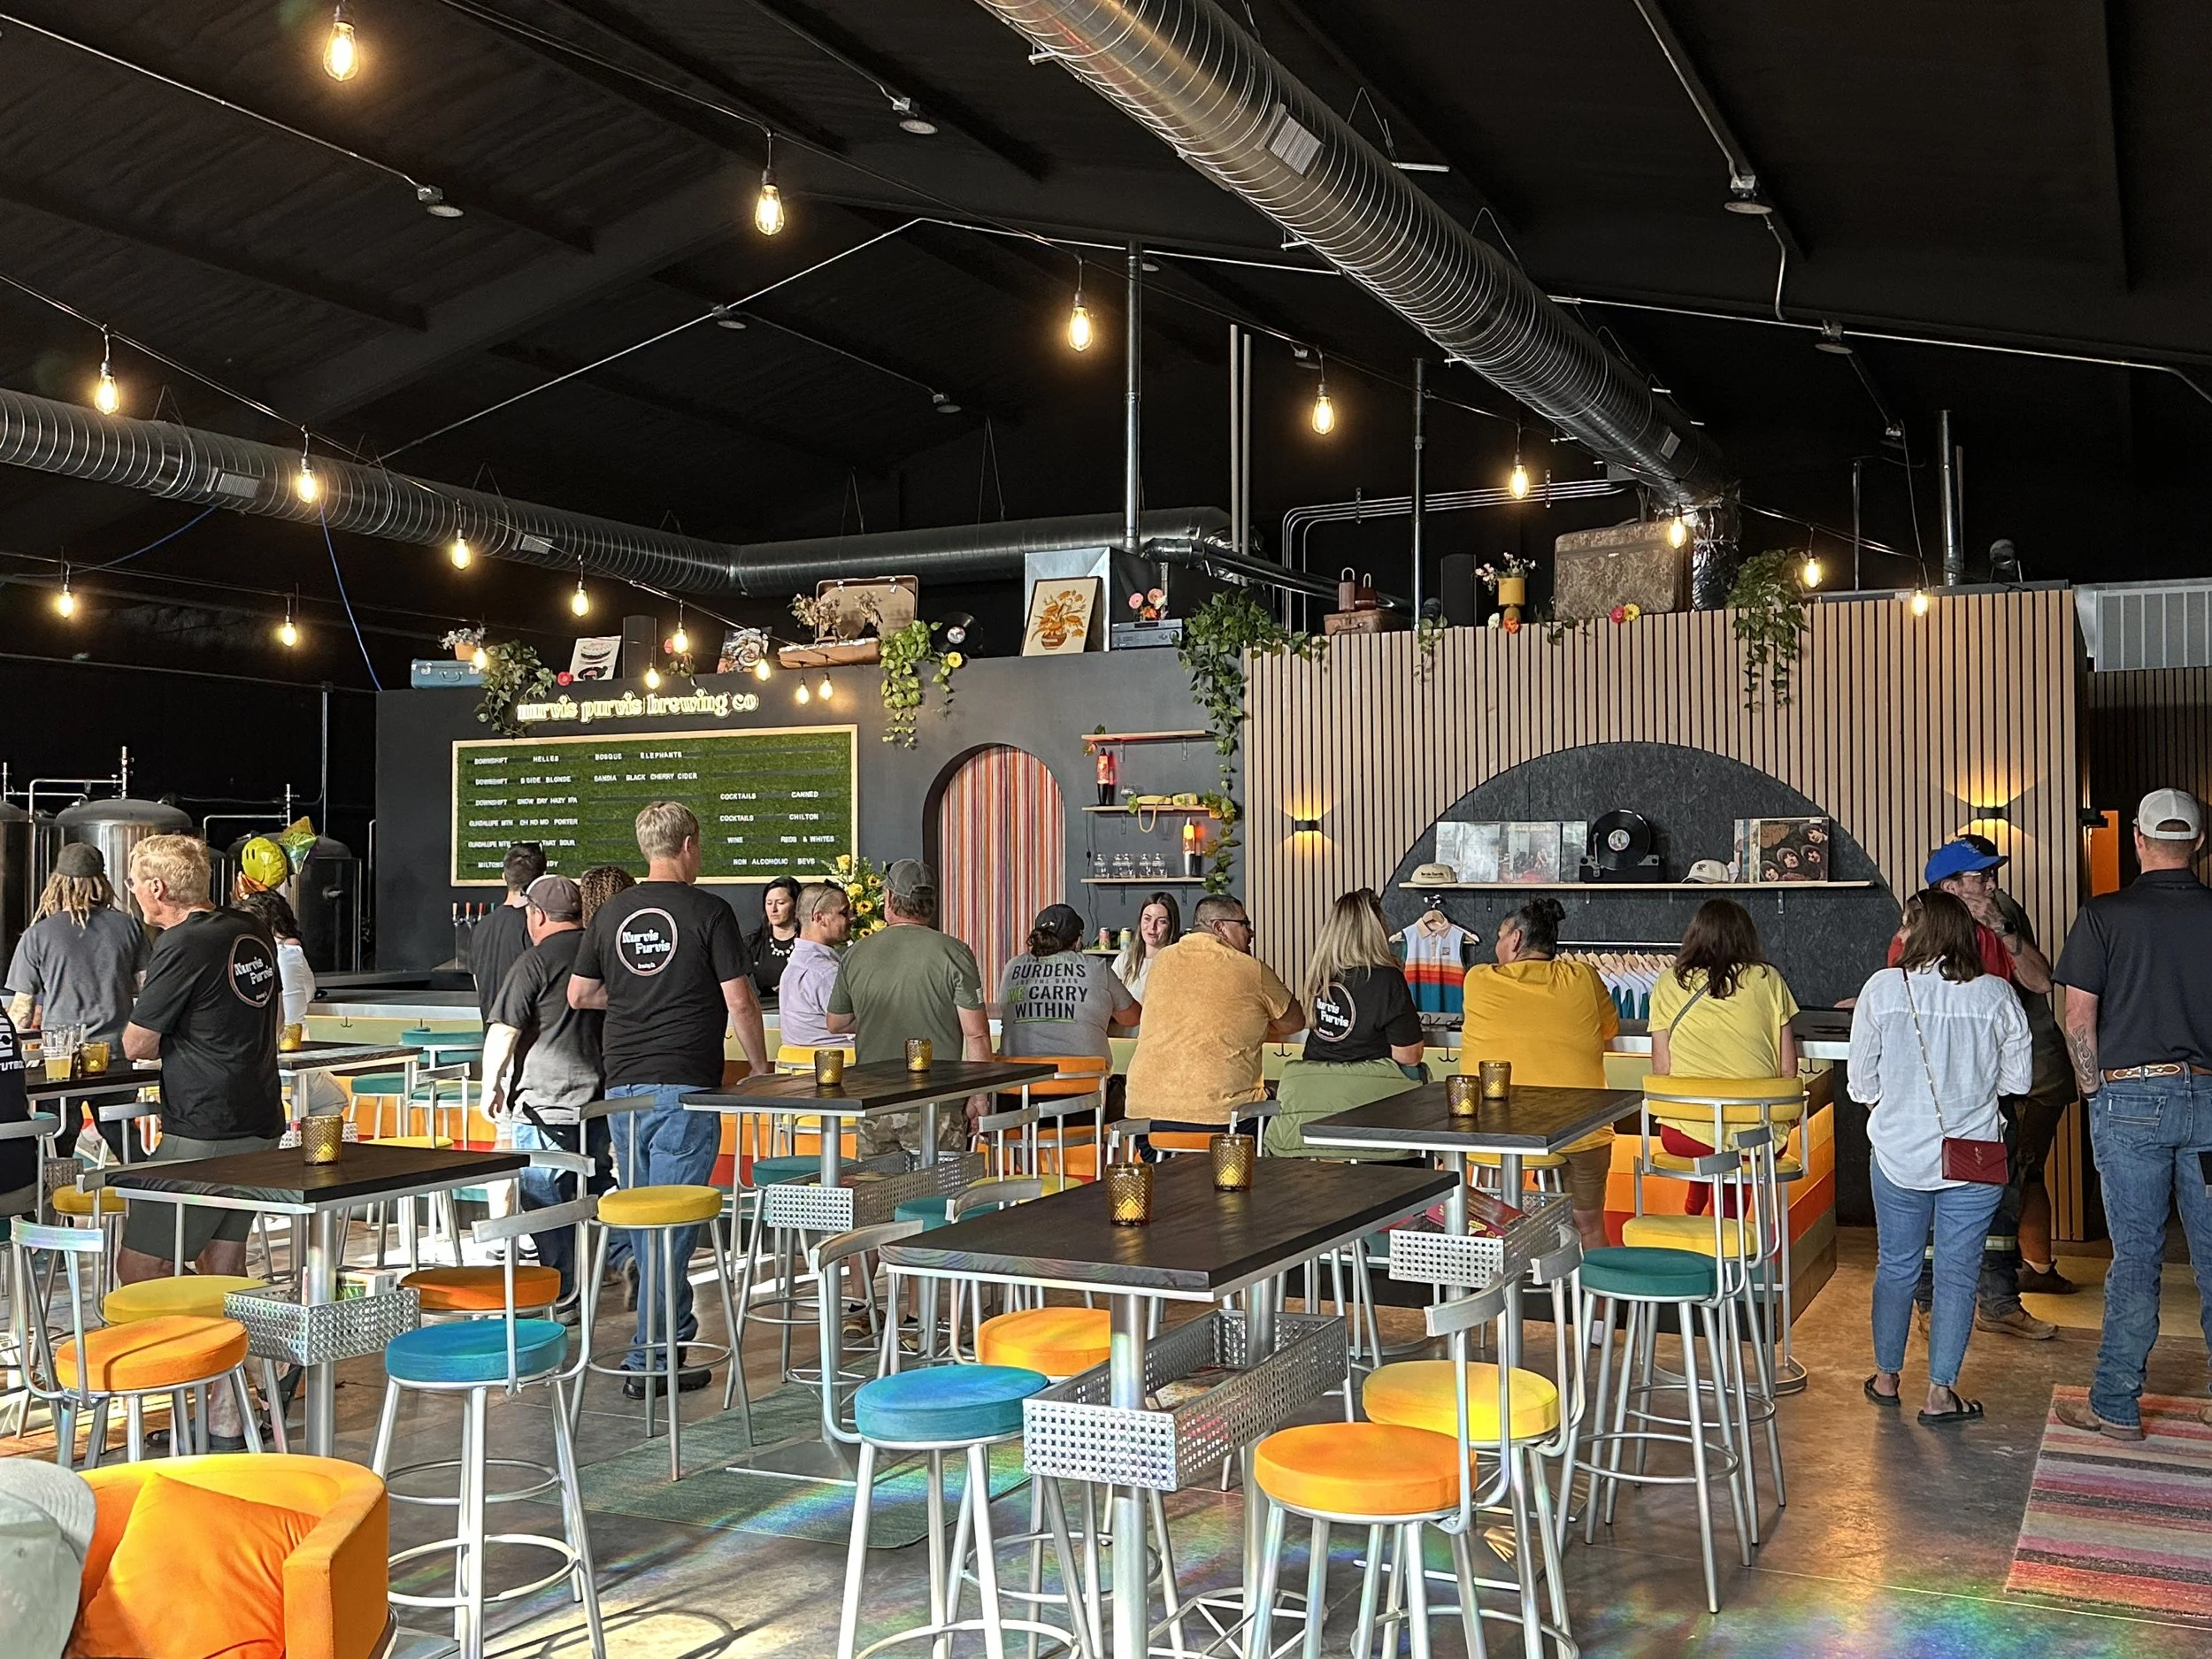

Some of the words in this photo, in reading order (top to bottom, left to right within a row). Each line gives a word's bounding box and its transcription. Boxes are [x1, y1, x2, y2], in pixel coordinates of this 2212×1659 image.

[647, 688, 728, 718] brewing
[732, 693, 758, 711] co
[622, 929, 659, 943] Nurvis
[635, 940, 671, 955] Purvis
[1011, 963, 1086, 980] BURDENS
[1007, 986, 1025, 1004] WE
[1028, 986, 1087, 1002] CARRY
[1015, 1002, 1075, 1018] WITHIN
[1321, 1010, 1349, 1027] Purvis
